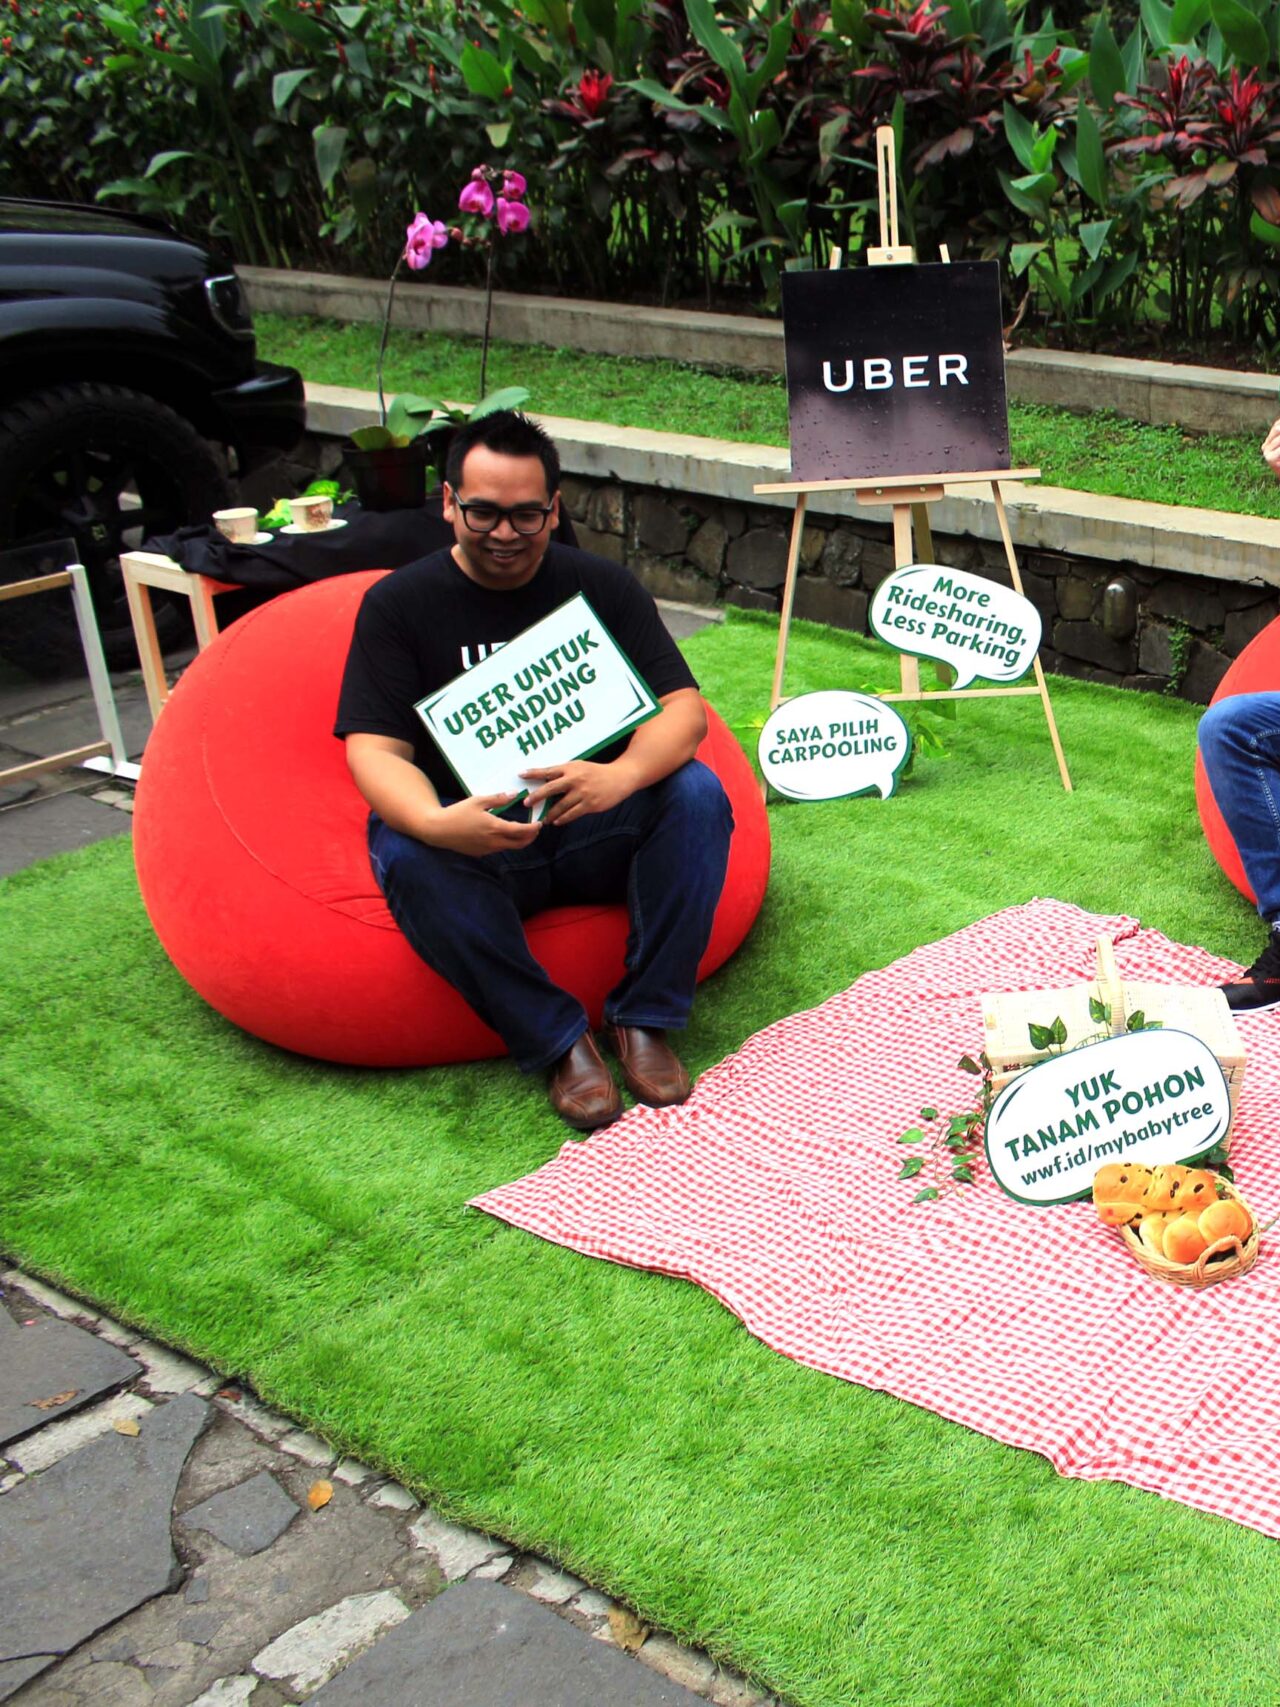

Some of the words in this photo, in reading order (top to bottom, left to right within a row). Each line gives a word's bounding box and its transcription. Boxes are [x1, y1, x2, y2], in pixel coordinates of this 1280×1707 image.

[822, 354, 969, 392] UBER
[887, 585, 1027, 646] Ridesharing,
[933, 576, 990, 607] More
[881, 608, 925, 635] Less
[931, 623, 1021, 668] Parking
[443, 682, 515, 735] UBER
[513, 629, 599, 691] UNTUK
[475, 662, 597, 749] BANDUNG
[516, 699, 586, 756] HIJAU
[768, 736, 898, 765] CARPOOLING
[776, 725, 823, 746] SAYA
[829, 719, 879, 739] PILIH
[1004, 1109, 1100, 1162] TANAM
[1101, 1065, 1206, 1124] POHON
[1064, 1070, 1122, 1108] YUK
[1021, 1102, 1214, 1186] wwf.id/mybabytree
